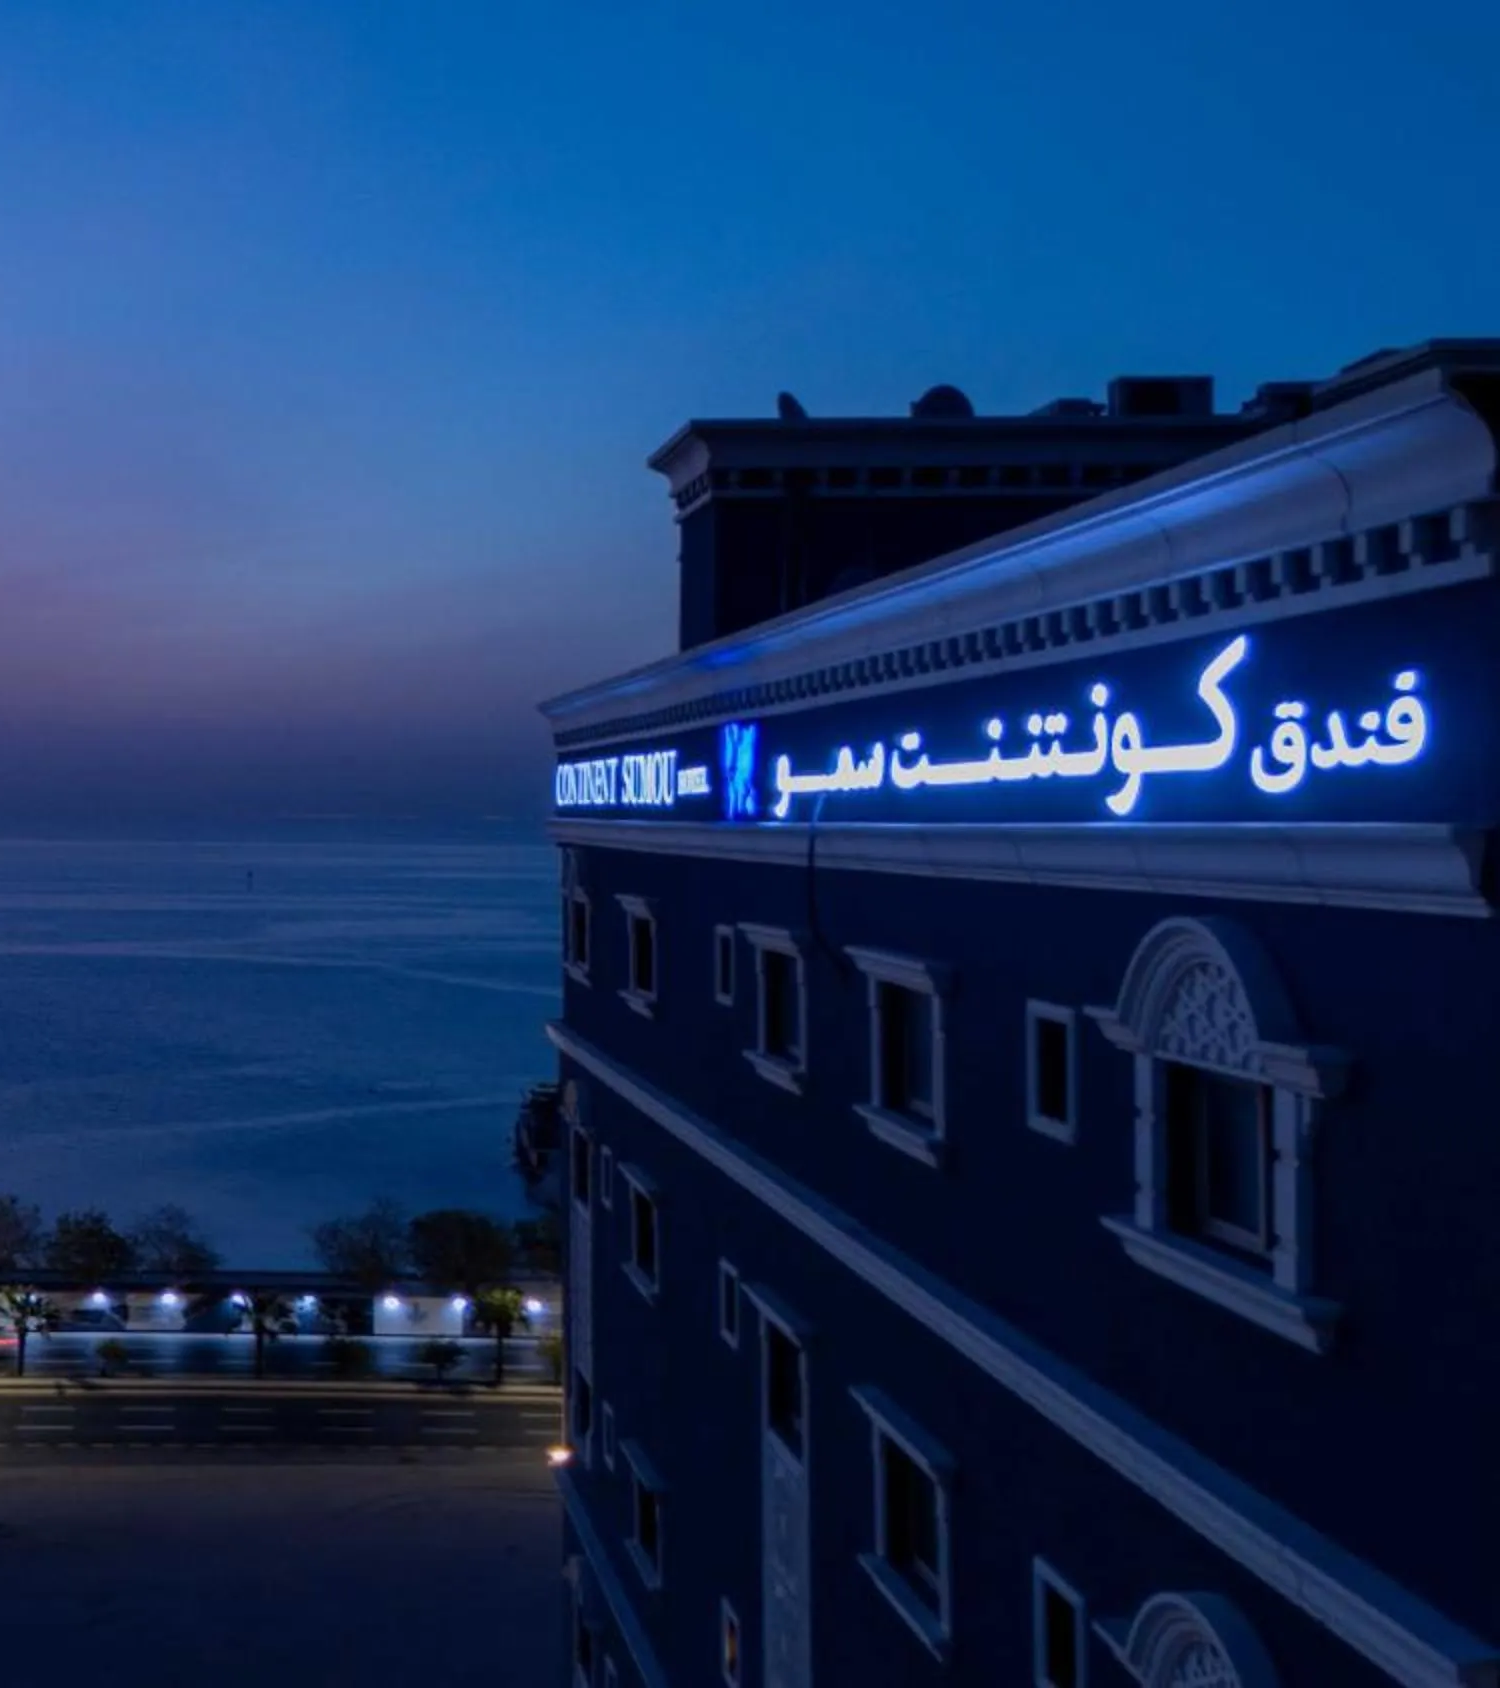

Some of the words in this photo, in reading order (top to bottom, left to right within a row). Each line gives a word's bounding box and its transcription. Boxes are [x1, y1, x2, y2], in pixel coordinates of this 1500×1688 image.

[1251, 672, 1425, 792] فندق
[556, 758, 617, 804] CONTINENT
[622, 751, 675, 803] SUMOU
[774, 743, 883, 816] سمو
